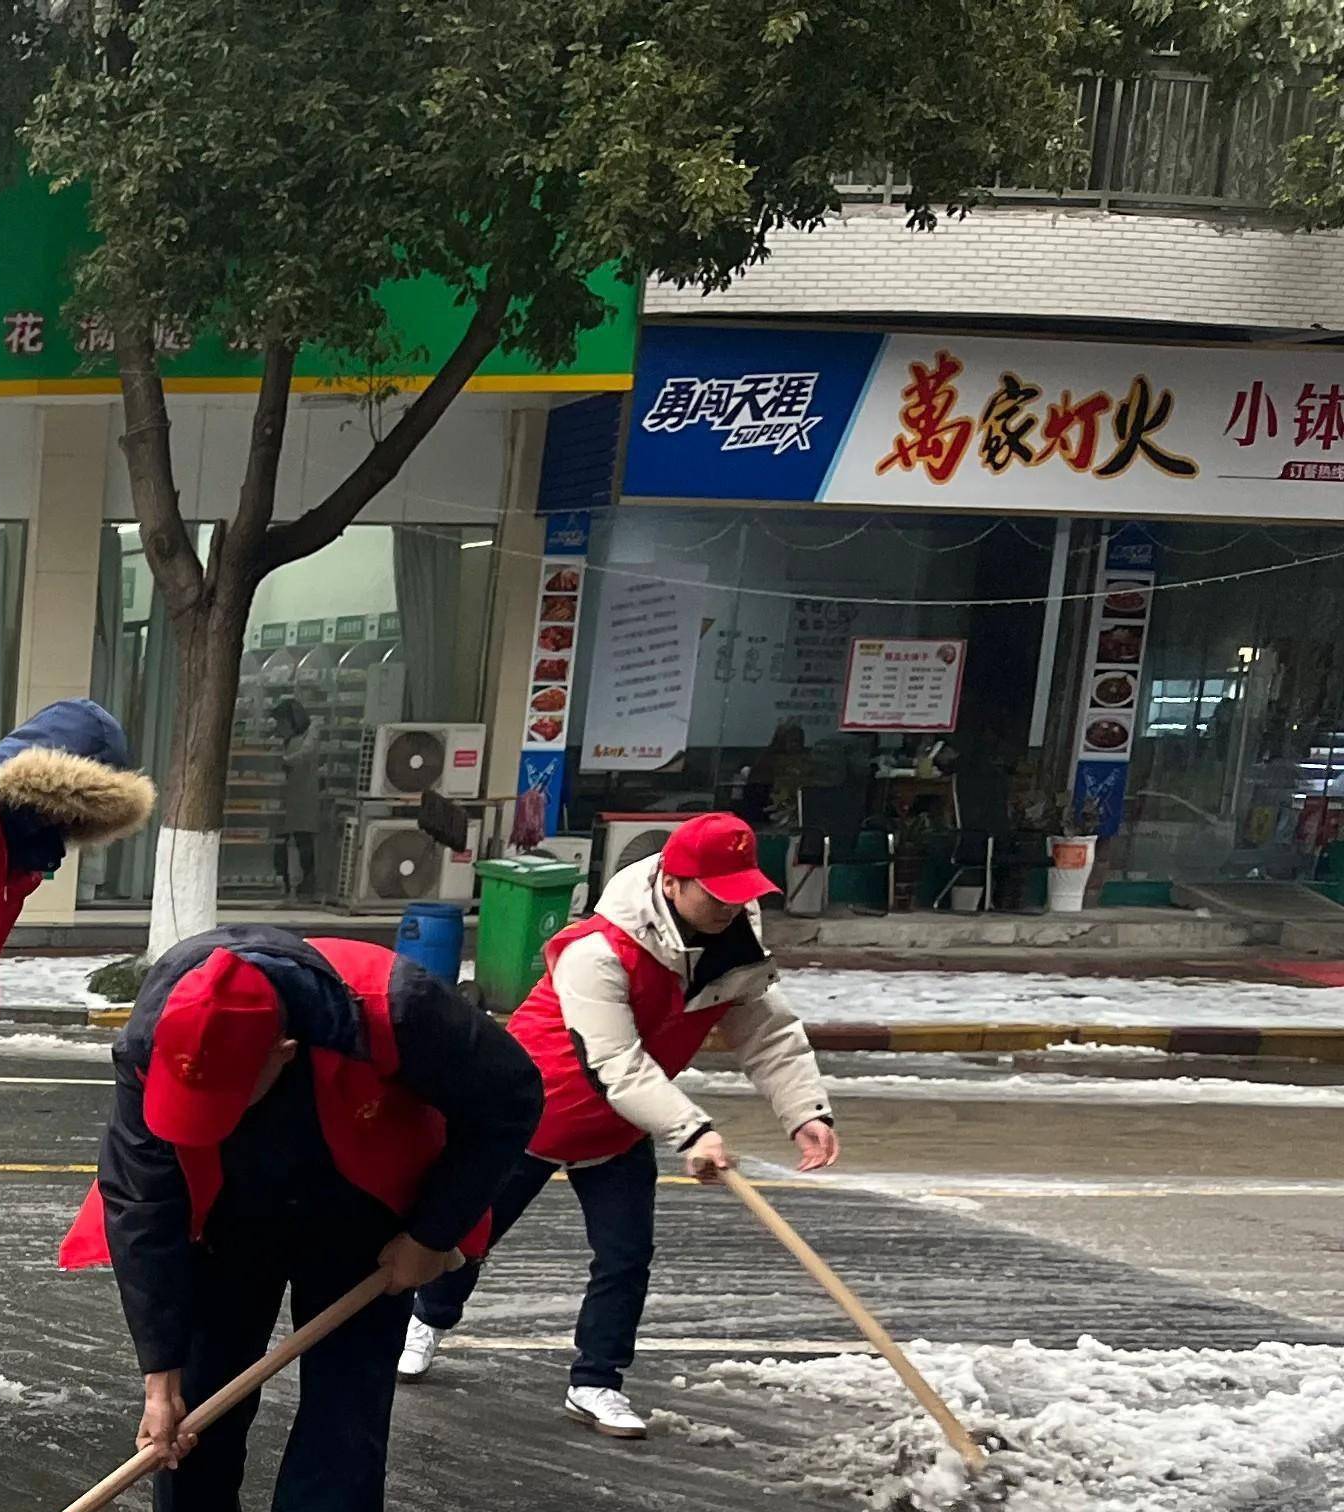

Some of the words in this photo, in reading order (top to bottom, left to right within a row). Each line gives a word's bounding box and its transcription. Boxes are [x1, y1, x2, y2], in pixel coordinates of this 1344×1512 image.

[642, 373, 819, 432] 勇闯天涯
[875, 350, 1200, 484] 萬家灯火
